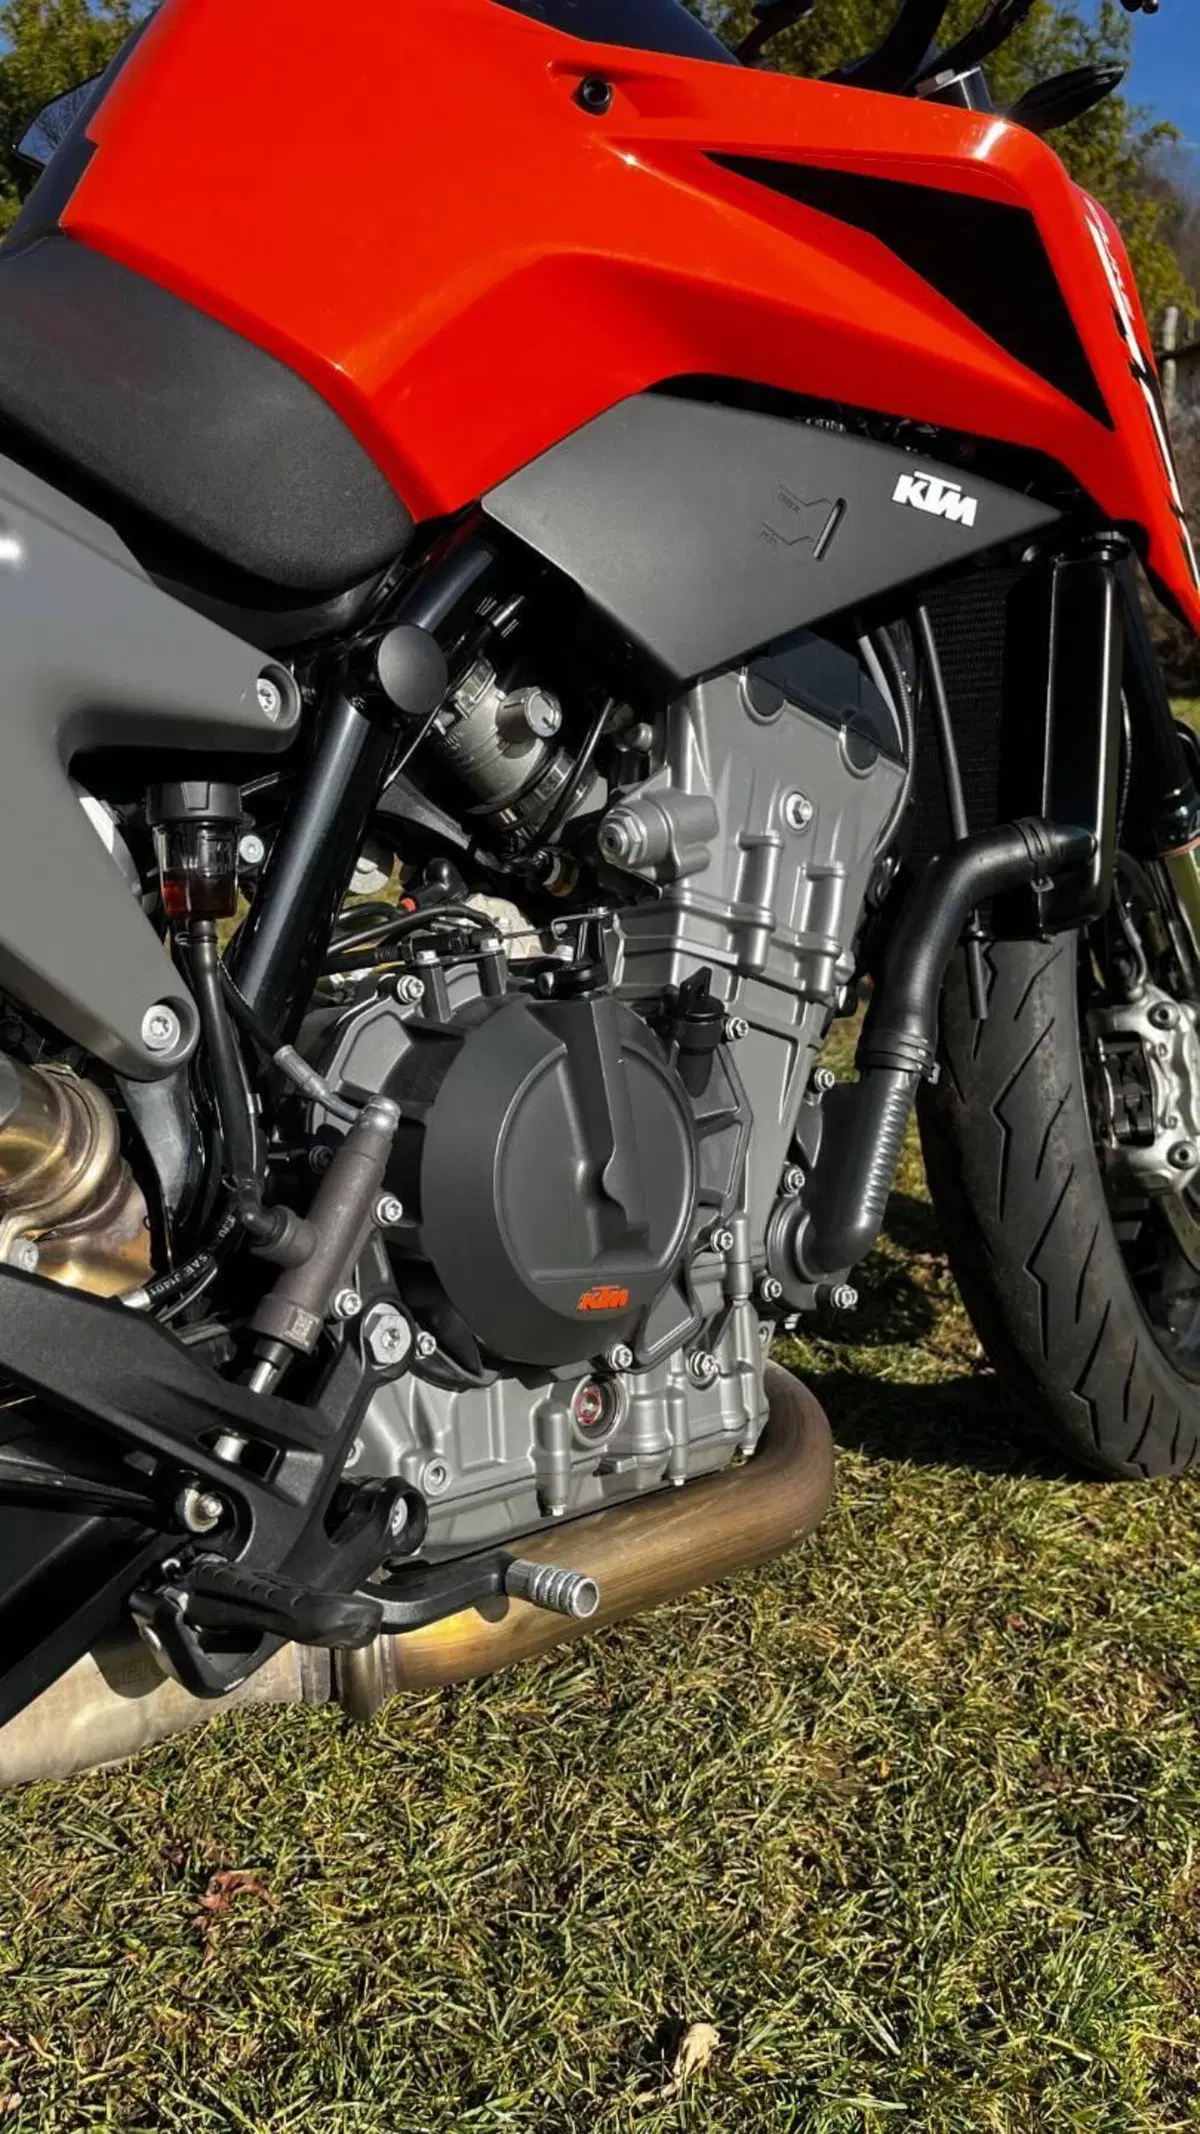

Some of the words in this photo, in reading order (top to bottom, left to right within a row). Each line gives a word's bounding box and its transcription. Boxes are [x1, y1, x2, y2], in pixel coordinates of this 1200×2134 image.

[891, 470, 978, 527] KTM
[184, 1253, 209, 1276] SAE
[150, 1274, 182, 1296] J1401
[576, 1285, 629, 1311] KTM
